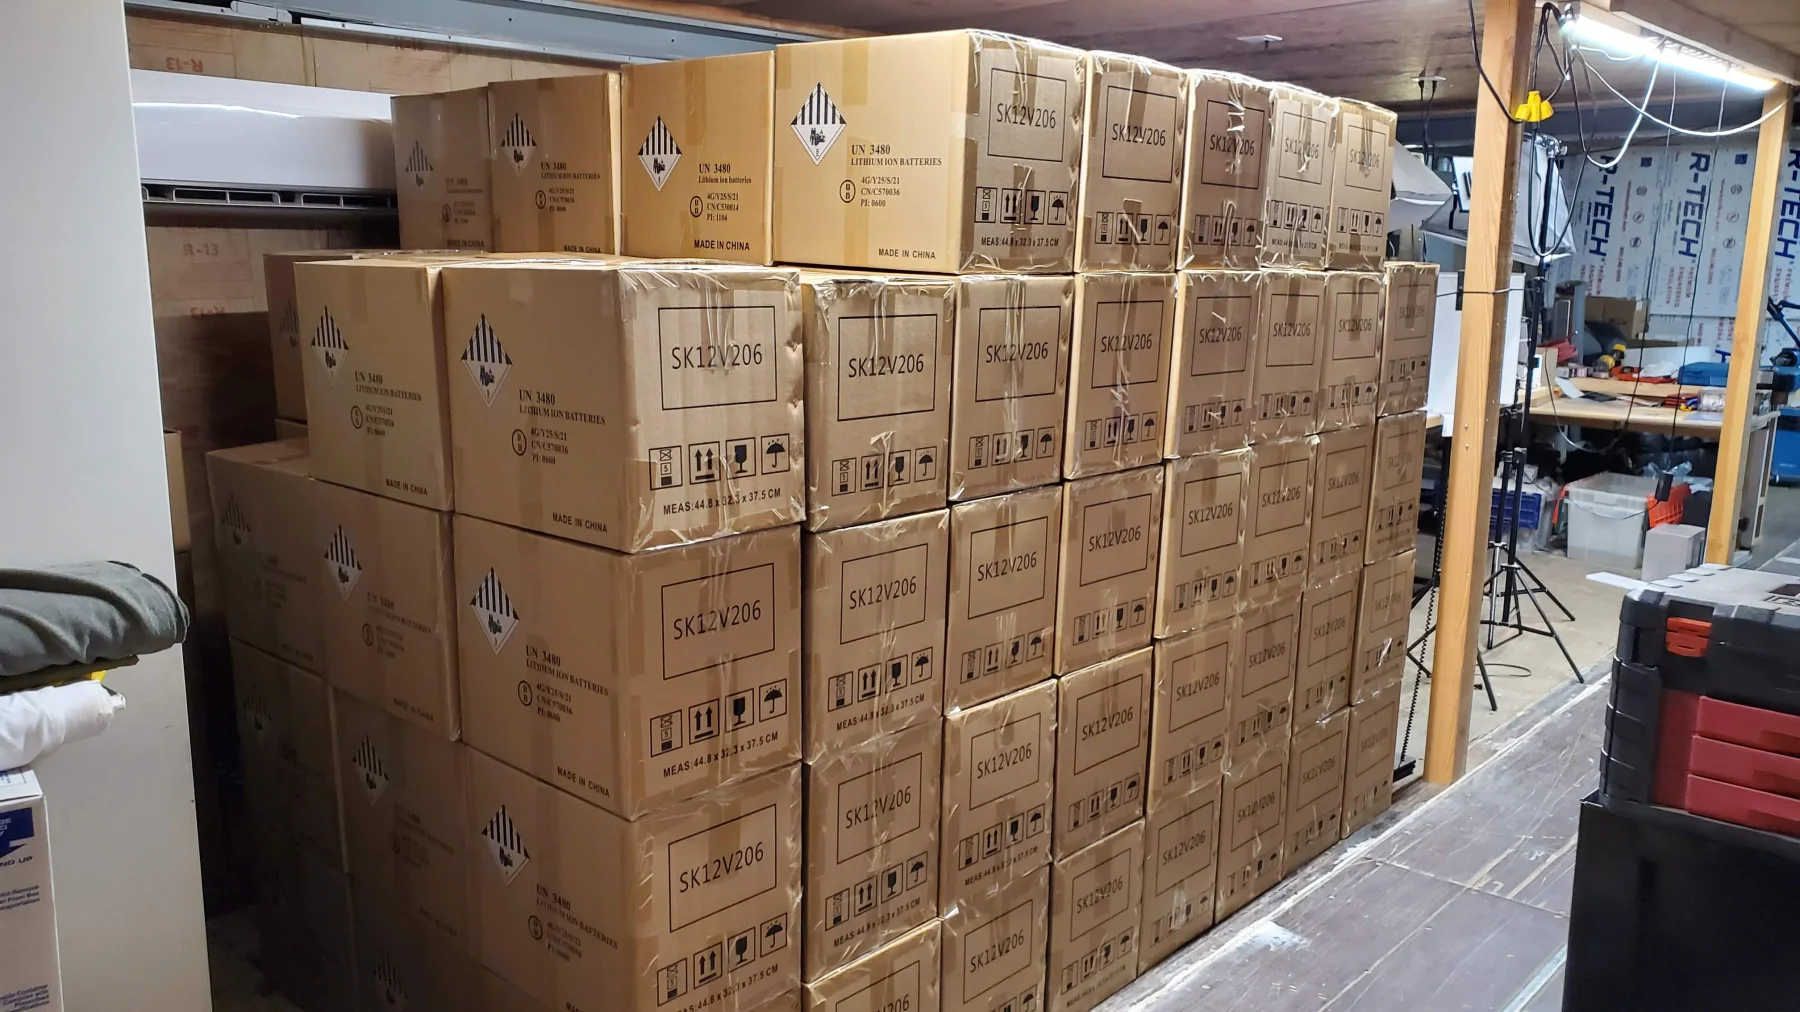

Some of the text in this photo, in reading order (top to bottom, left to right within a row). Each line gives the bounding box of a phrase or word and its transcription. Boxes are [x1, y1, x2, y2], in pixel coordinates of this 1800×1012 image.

[166, 56, 203, 73] R-13
[996, 103, 1056, 129] SK12V206
[1112, 123, 1166, 147] SK12V206
[1210, 134, 1255, 156] SK12V206
[851, 144, 891, 155] UN 3480
[699, 163, 731, 173] UN 3480
[851, 157, 942, 166] LITHIUM ION BATTERIES
[860, 187, 900, 196] CN/C570036
[861, 176, 900, 185] 4G/Y25/S/21
[860, 199, 886, 207] PI: 0600
[1589, 155, 1618, 257] R-TECH
[1678, 151, 1711, 258] R-TECH
[1775, 149, 1800, 260] R-TECH
[183, 243, 219, 256] R-13
[694, 239, 750, 251] MADE IN CHINA
[878, 248, 936, 259] MADE IN CHINA
[1037, 238, 1049, 247] 37.5
[1050, 238, 1059, 247] CM
[1199, 326, 1242, 343] SK12V206
[1273, 322, 1311, 337] SK12V206
[1338, 318, 1372, 333] SK12V206
[985, 342, 1048, 363] SK12V206
[1101, 333, 1152, 353] SK12V206
[671, 343, 763, 370] SK12V206
[848, 353, 924, 378] SK12V206
[354, 371, 383, 385] UN 3480
[391, 389, 421, 401] BATTERIES
[519, 389, 555, 405] UN 3480
[519, 405, 606, 425] LITHIUM ION BATTERIES
[385, 478, 428, 496] MADE IN CHINA
[1262, 486, 1301, 508] SK12V206
[663, 497, 713, 515] MEAS:44.8
[748, 490, 767, 502] 37.5
[768, 488, 781, 499] CM
[552, 512, 608, 533] MADE IN CHINA
[1188, 502, 1233, 525] SK12V206
[1088, 526, 1141, 552] SK12V206
[977, 551, 1037, 581] SK12V206
[849, 576, 917, 610] SK12V206
[673, 600, 761, 640] SK12V206
[1313, 615, 1346, 640] SK12V206
[526, 645, 561, 667] UN 3480
[1248, 642, 1286, 669] SK12V206
[526, 659, 609, 696] LITHIUM ION BATTERIES
[1176, 671, 1220, 701] SK12V206
[915, 693, 925, 704] CM
[1082, 706, 1134, 741] SK12V206
[663, 753, 712, 778] MEAS:44.8
[746, 737, 764, 750] 37.5
[765, 731, 778, 743] CM
[977, 742, 1032, 779] SK12V206
[557, 766, 610, 798] MADE IN CHINA
[845, 785, 911, 828] SK12V206
[1162, 830, 1206, 866] SK12V206
[679, 841, 764, 893] SK12V206
[536, 884, 571, 911] UN 3480
[1077, 876, 1123, 914] SK12V206
[970, 929, 1024, 973] SK12V206
[748, 971, 765, 985] 37.5
[766, 964, 778, 976] CM
